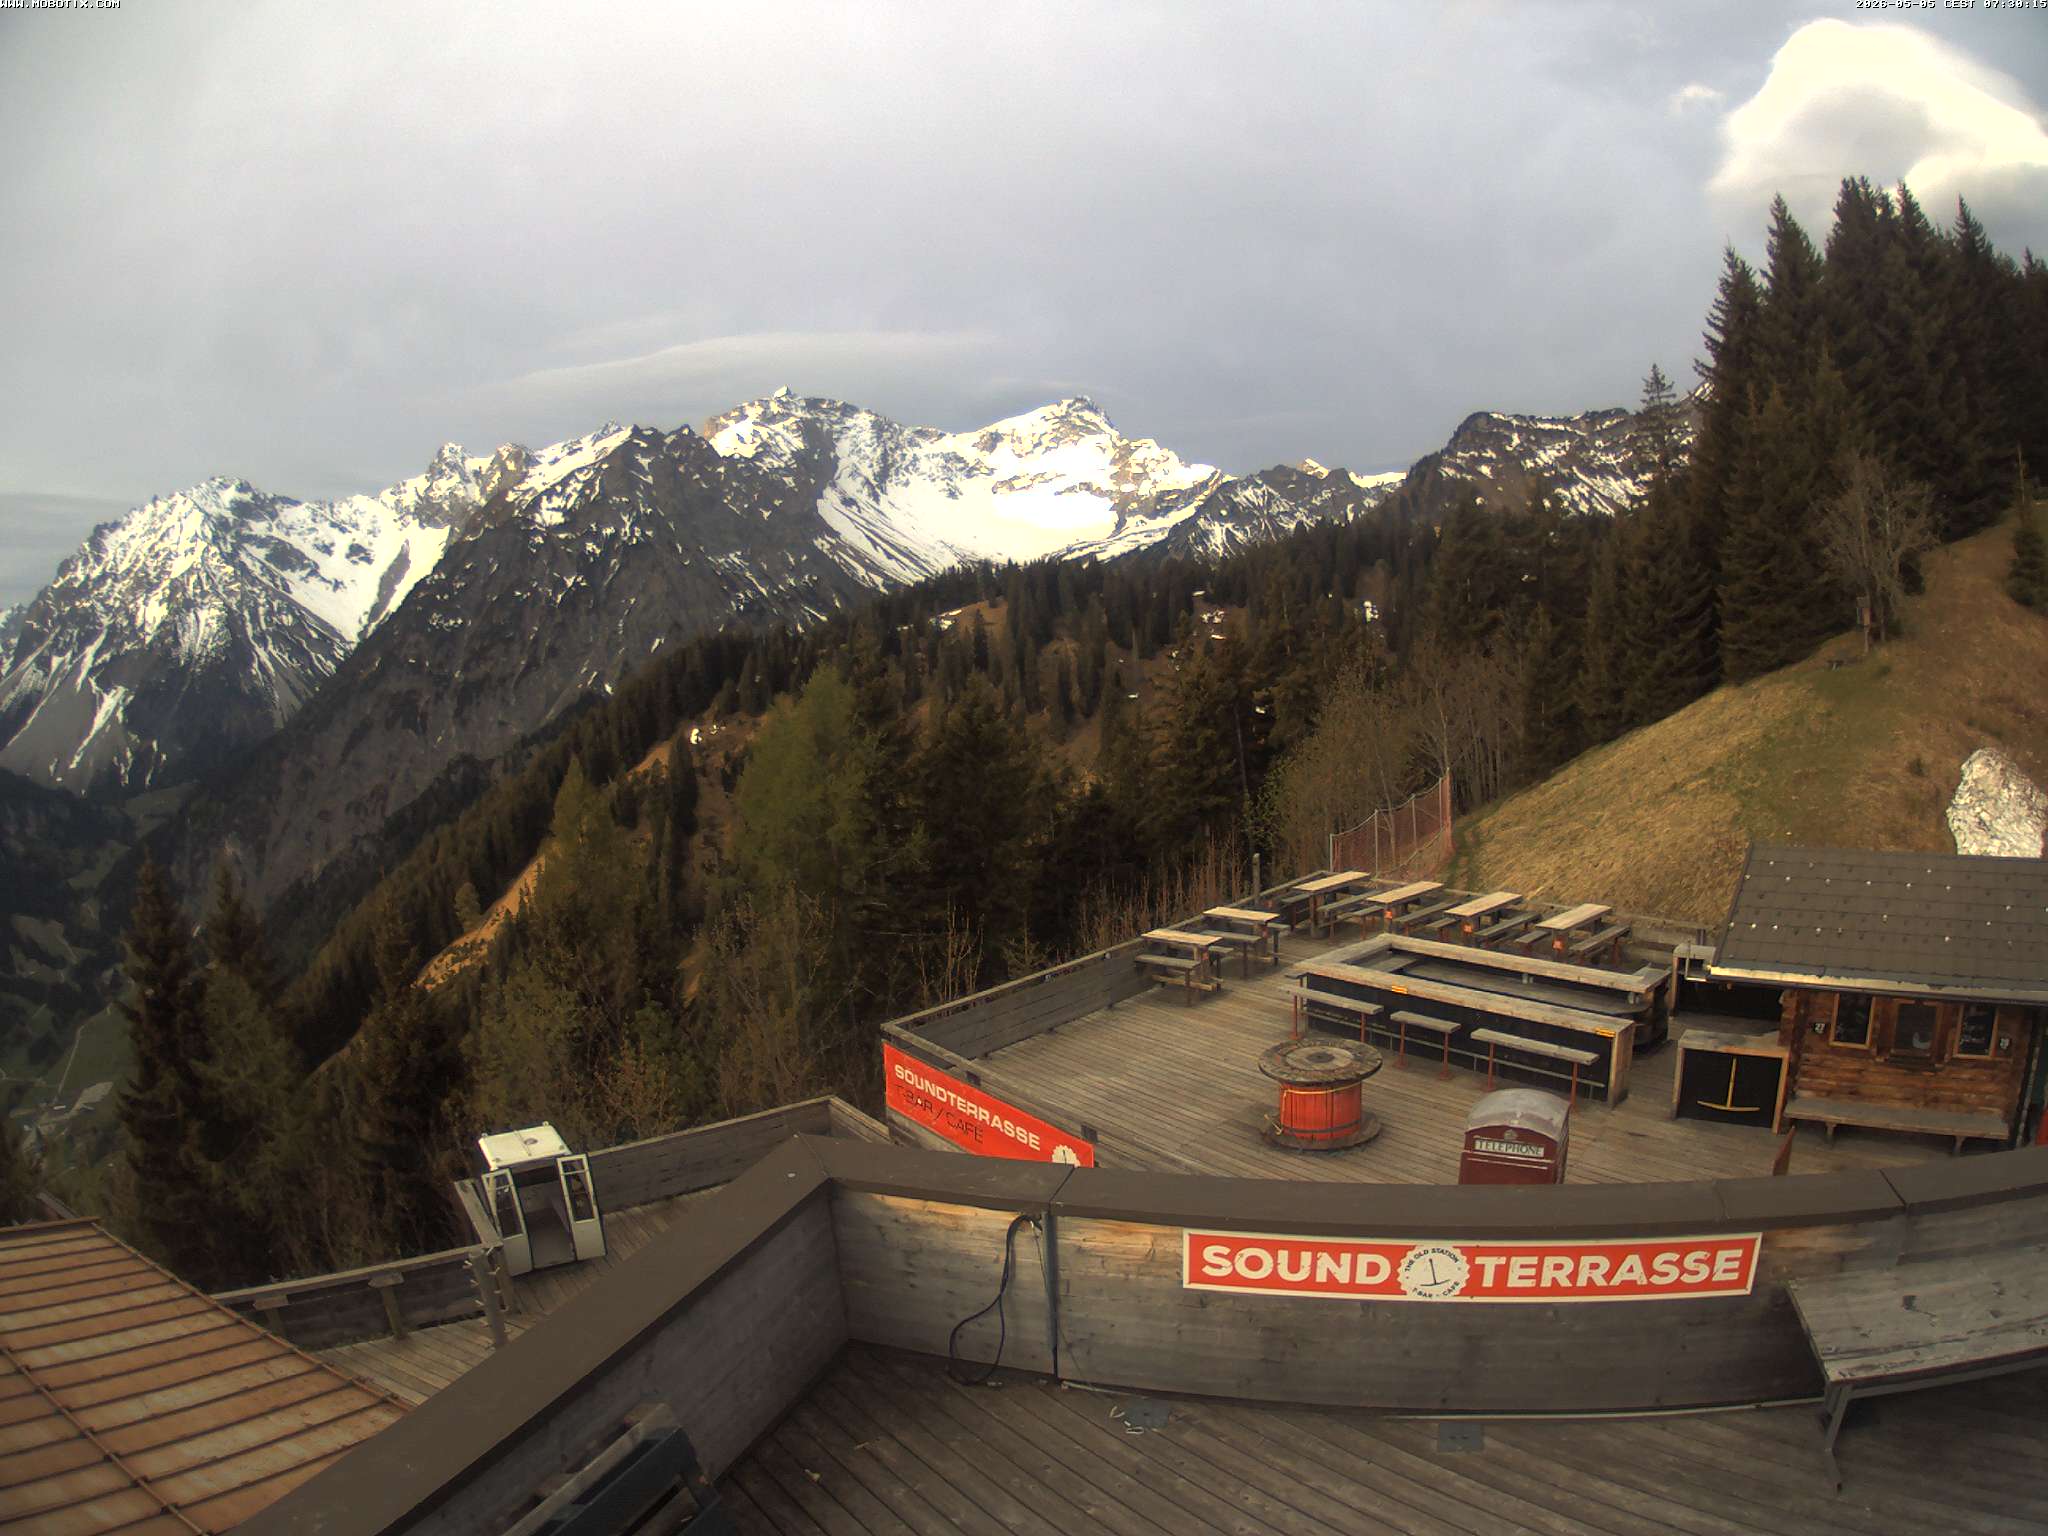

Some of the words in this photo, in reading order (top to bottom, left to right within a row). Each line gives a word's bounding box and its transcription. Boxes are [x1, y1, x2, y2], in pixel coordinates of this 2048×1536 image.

[894, 1064, 1041, 1151] SOUNDTERRASSE
[1475, 1140, 1543, 1156] TELEPHONE
[1201, 1245, 1391, 1285] SOUND
[1474, 1249, 1744, 1288] TERRASSE
[1404, 1260, 1415, 1272] THE
[1414, 1249, 1429, 1259] OLD
[1431, 1248, 1459, 1263] STATION
